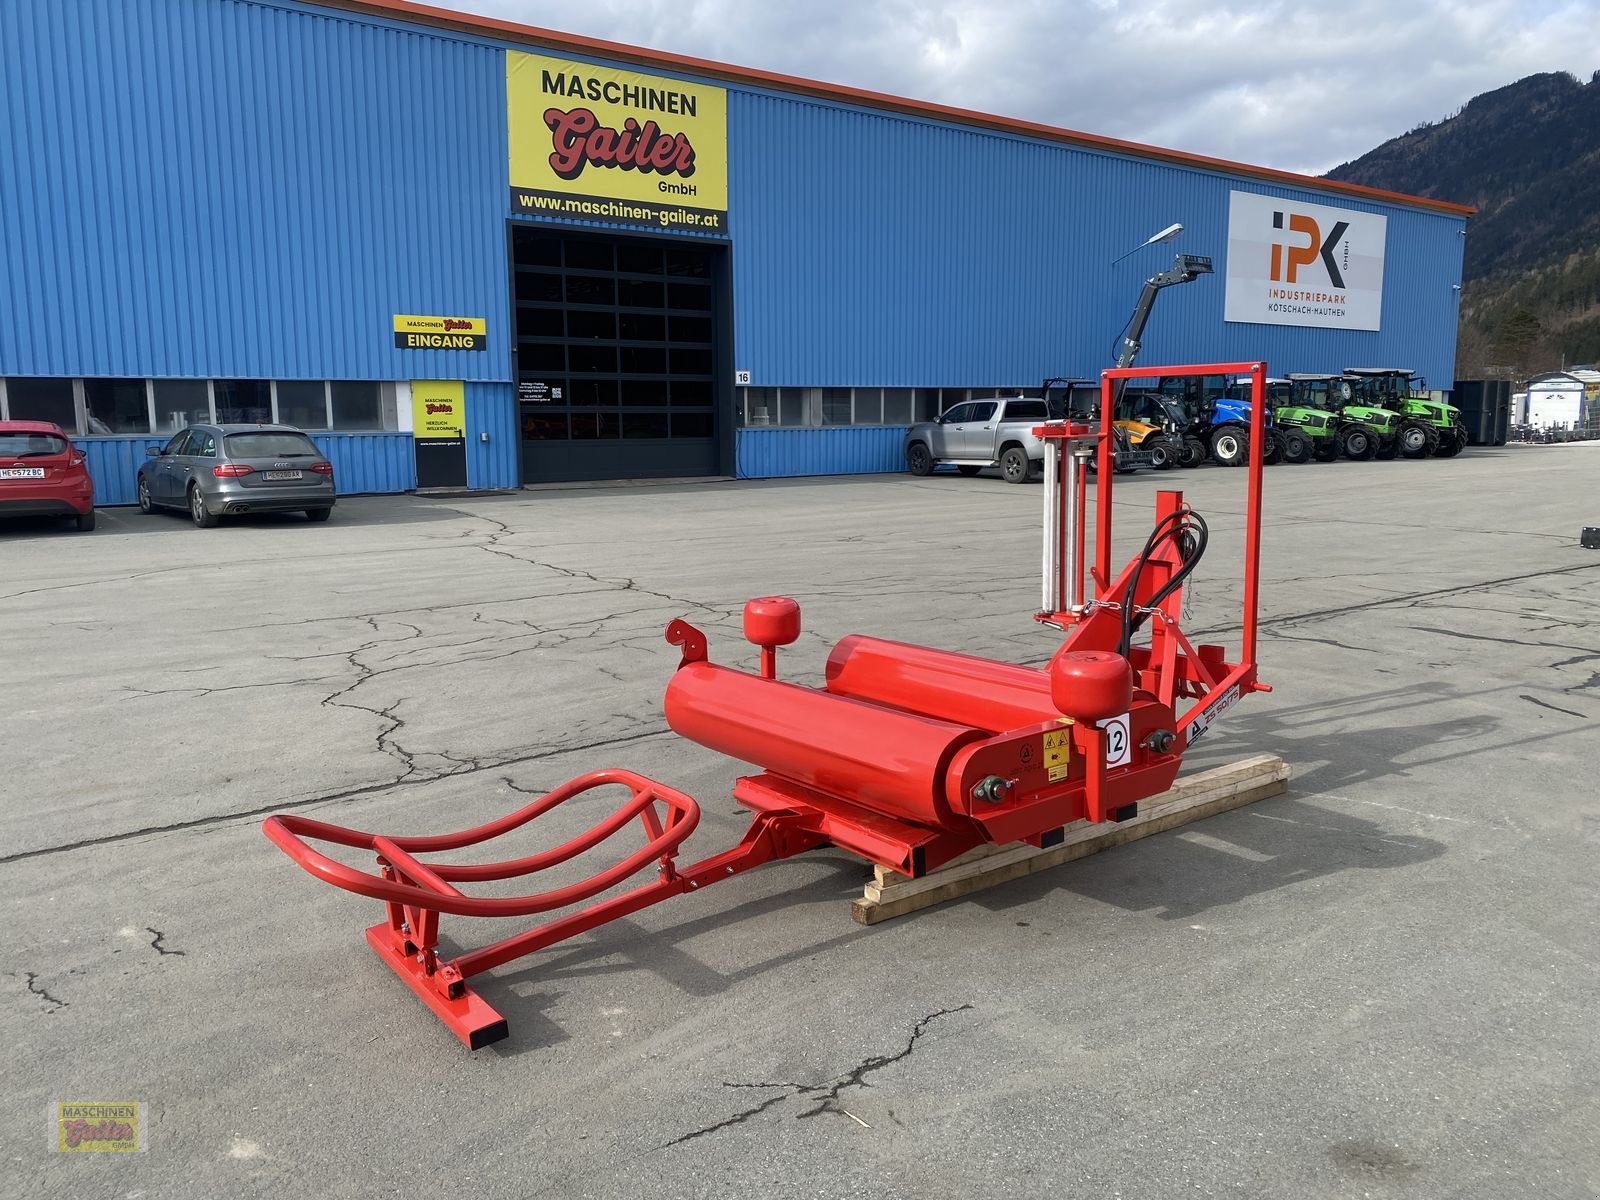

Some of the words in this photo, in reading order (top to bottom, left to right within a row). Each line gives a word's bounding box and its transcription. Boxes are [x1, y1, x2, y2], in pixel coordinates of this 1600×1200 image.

[542, 69, 697, 117] MASCHINEN
[543, 108, 696, 180] Gailer
[658, 181, 697, 196] GmbH
[519, 193, 719, 227] www.maschinen-gailer.at
[1269, 288, 1346, 304] INDUSTRIEPARK
[443, 318, 473, 331] Gailer
[407, 334, 474, 348] EINGANG
[738, 373, 748, 383] 16
[1216, 688, 1239, 714] 50/75
[1107, 730, 1123, 754] 12
